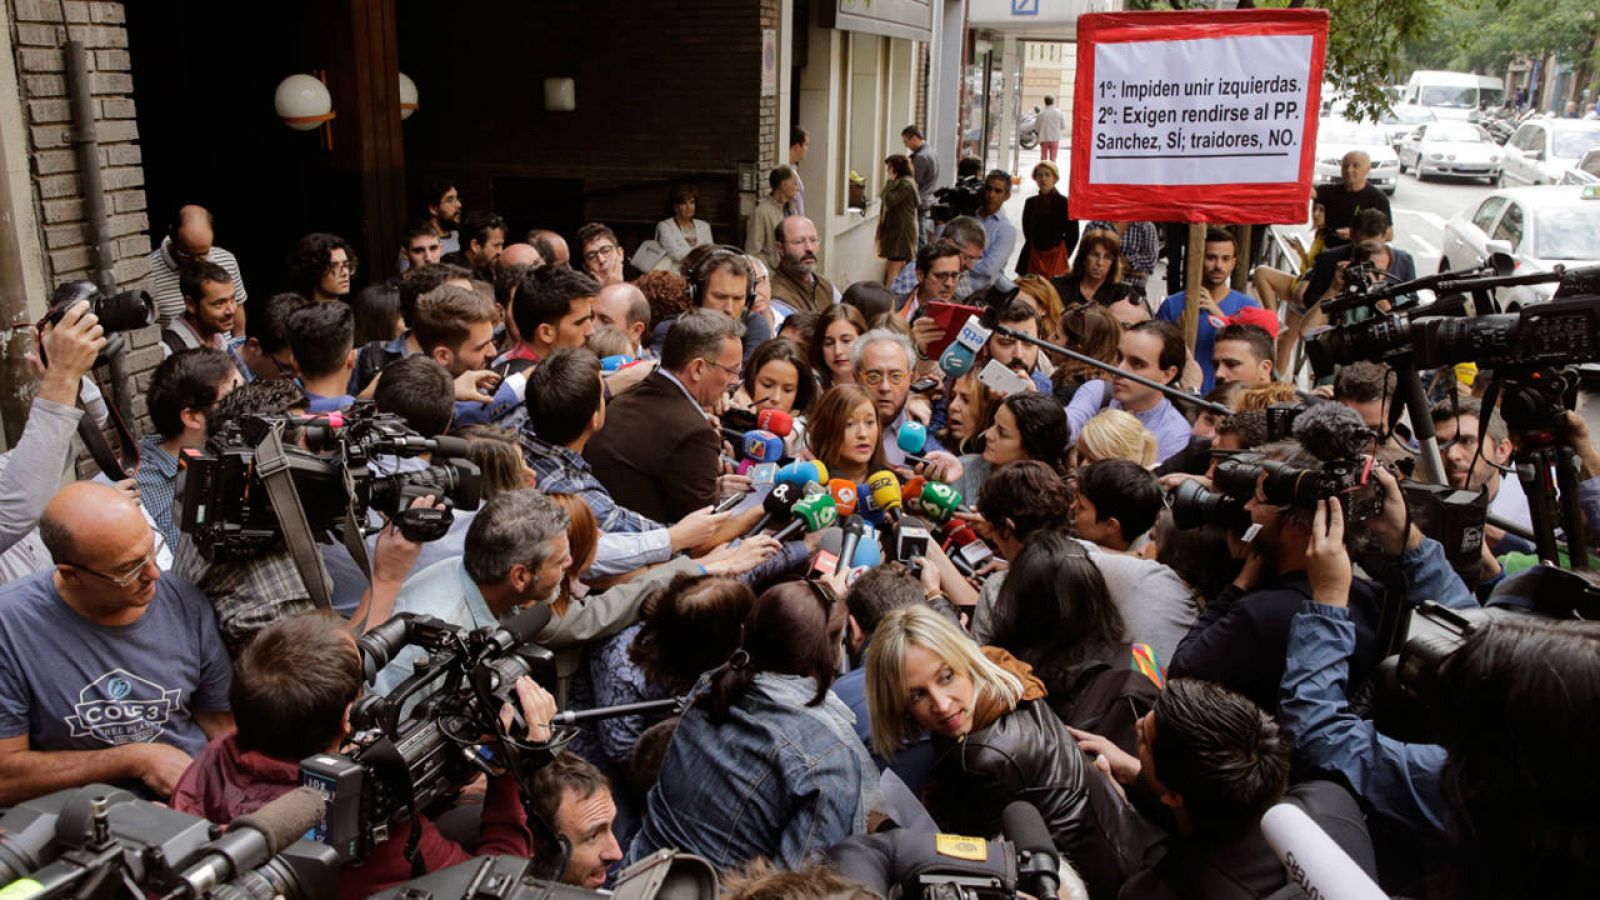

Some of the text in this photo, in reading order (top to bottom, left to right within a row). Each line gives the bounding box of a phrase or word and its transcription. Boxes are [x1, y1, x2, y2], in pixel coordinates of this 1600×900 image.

[1121, 79, 1180, 101] Impiden
[1184, 78, 1213, 97] unir
[1218, 75, 1301, 100] izquierdas.
[1123, 106, 1177, 128] Exigen
[1181, 103, 1249, 123] rendirse
[1254, 102, 1269, 121] al
[1273, 102, 1299, 121] PP.
[1096, 131, 1161, 152] Sanchez,
[1190, 130, 1263, 149] traidores,
[1268, 128, 1297, 147] NO.
